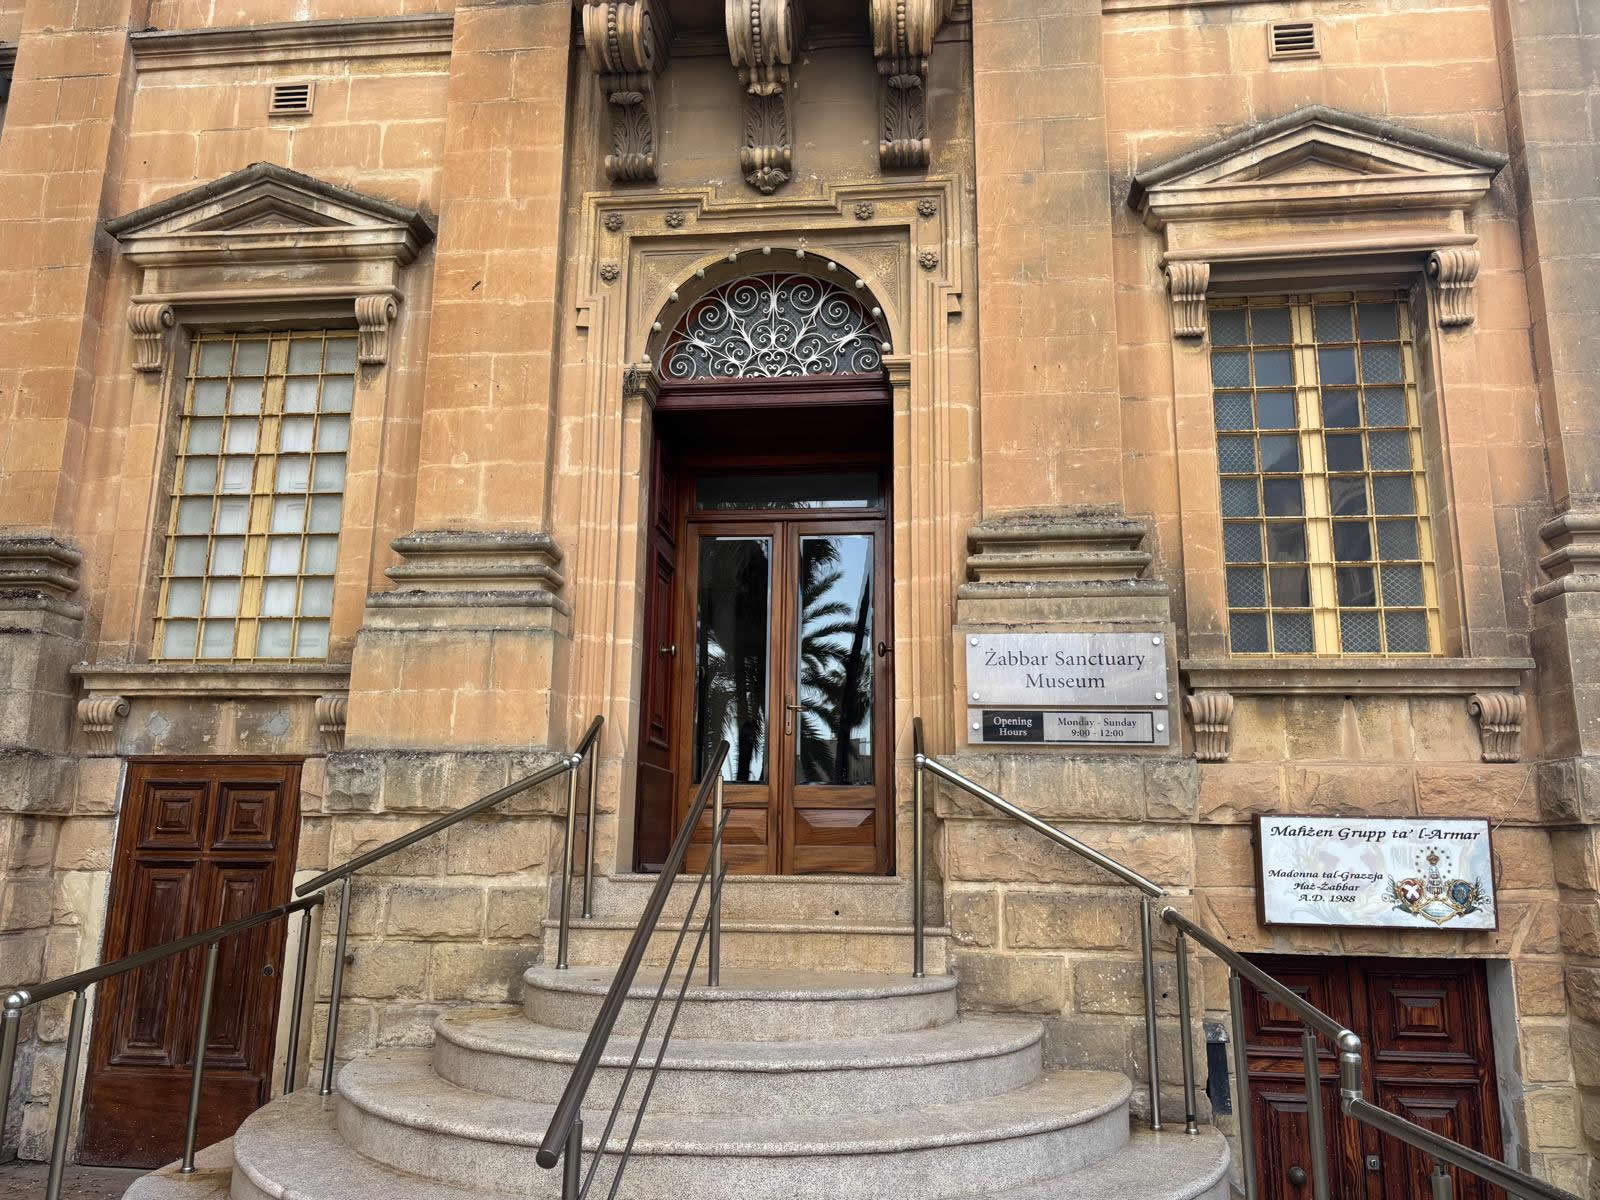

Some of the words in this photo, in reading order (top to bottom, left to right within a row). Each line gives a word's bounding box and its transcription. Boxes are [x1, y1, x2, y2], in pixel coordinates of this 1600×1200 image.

[984, 648, 1048, 666] Żabbar
[1055, 651, 1145, 670] Sanctuary
[1026, 674, 1105, 688] Museum
[993, 717, 1032, 727] Opening
[1057, 718, 1095, 727] Monday
[1103, 719, 1137, 728] Sunday
[999, 727, 1027, 736] Hours
[1338, 827, 1386, 842] Grupp
[1418, 828, 1480, 841] l-Armar
[1268, 870, 1318, 879] Madonna
[1322, 870, 1384, 882] tal-Grazzja
[1298, 894, 1326, 902] A.D.
[1329, 894, 1356, 903] 1988
